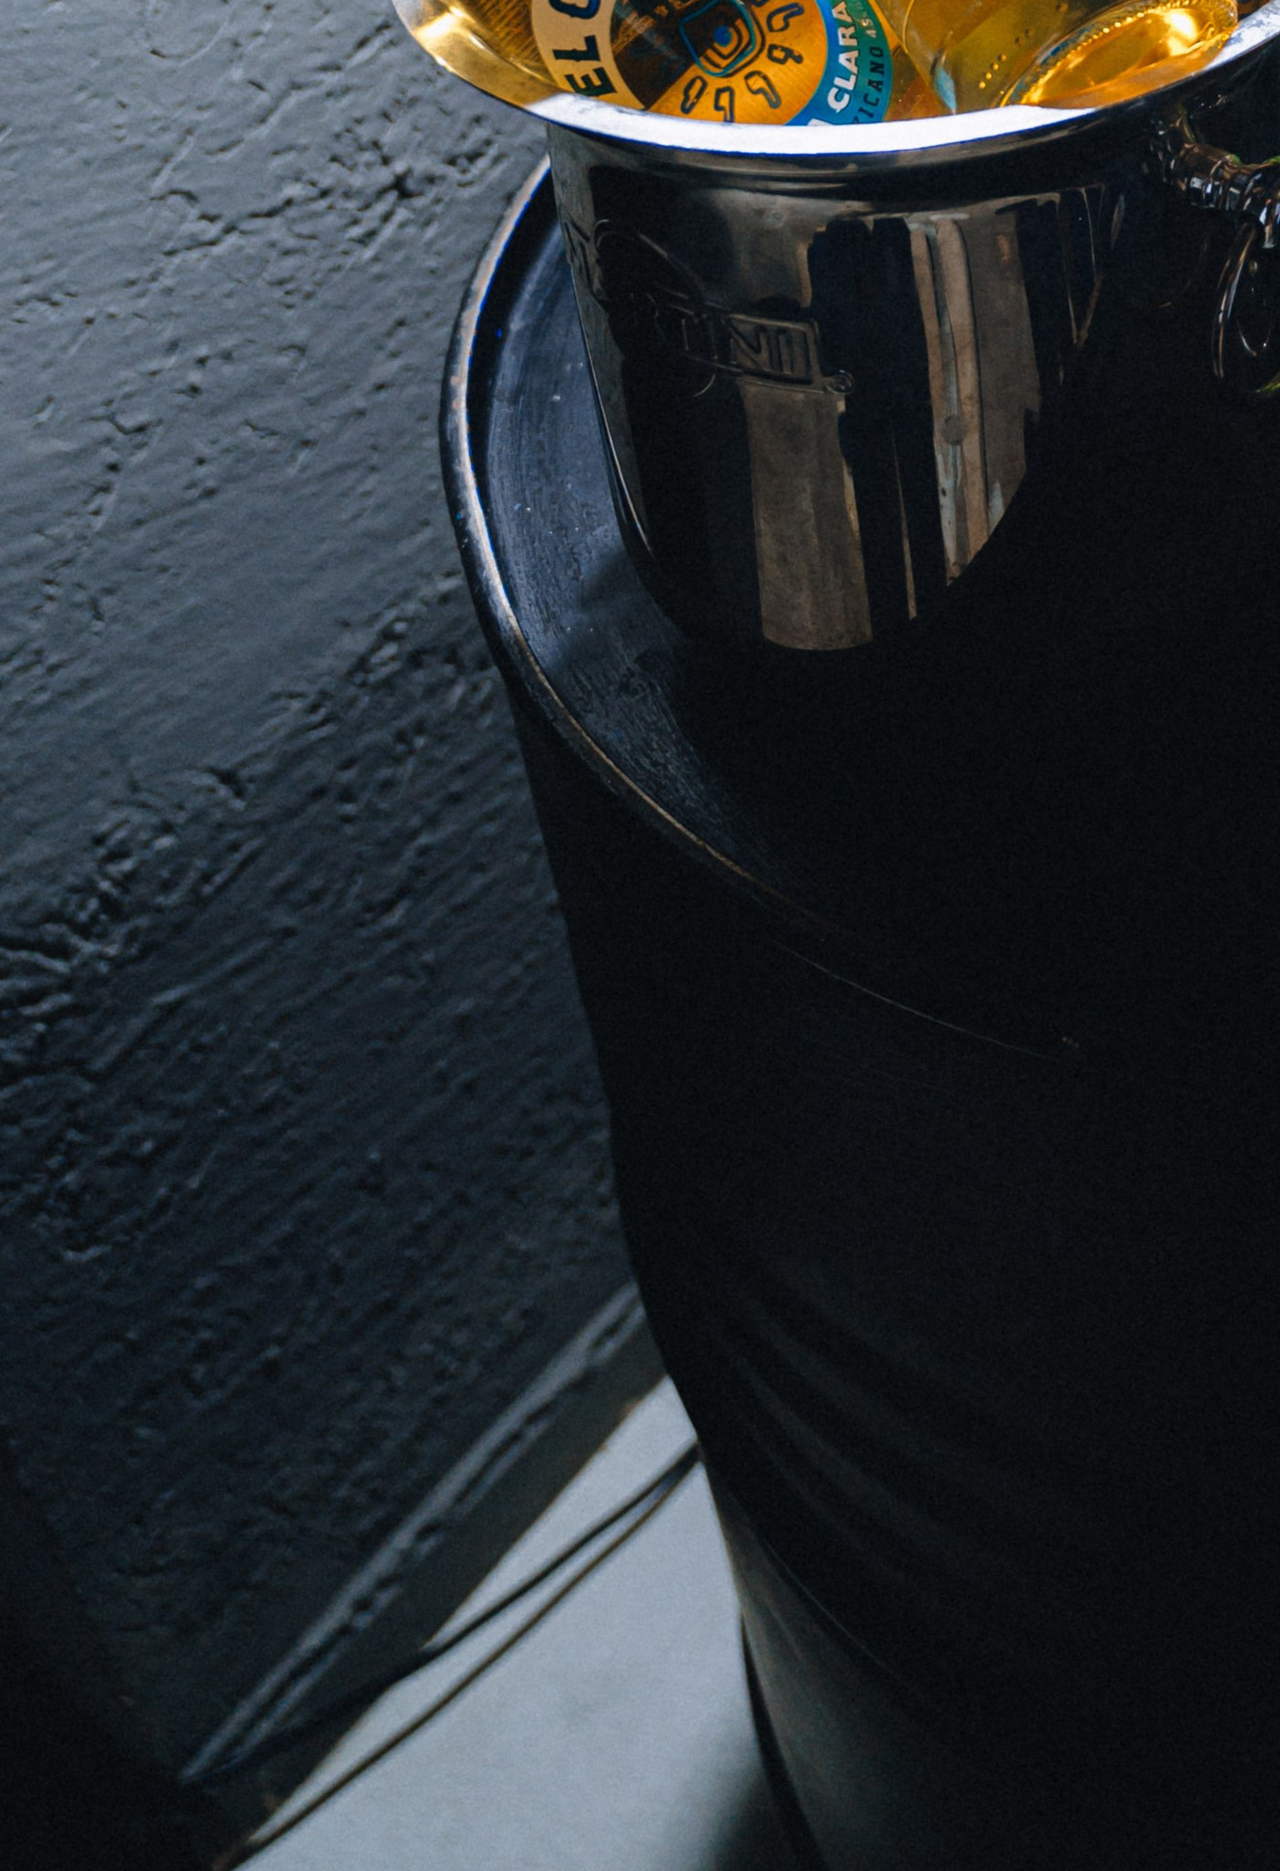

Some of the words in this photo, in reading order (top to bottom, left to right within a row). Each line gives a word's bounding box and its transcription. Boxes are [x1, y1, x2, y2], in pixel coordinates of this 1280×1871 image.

[552, 34, 617, 97] EL
[827, 1, 858, 113] CLARA
[853, 46, 885, 124] ICANO
